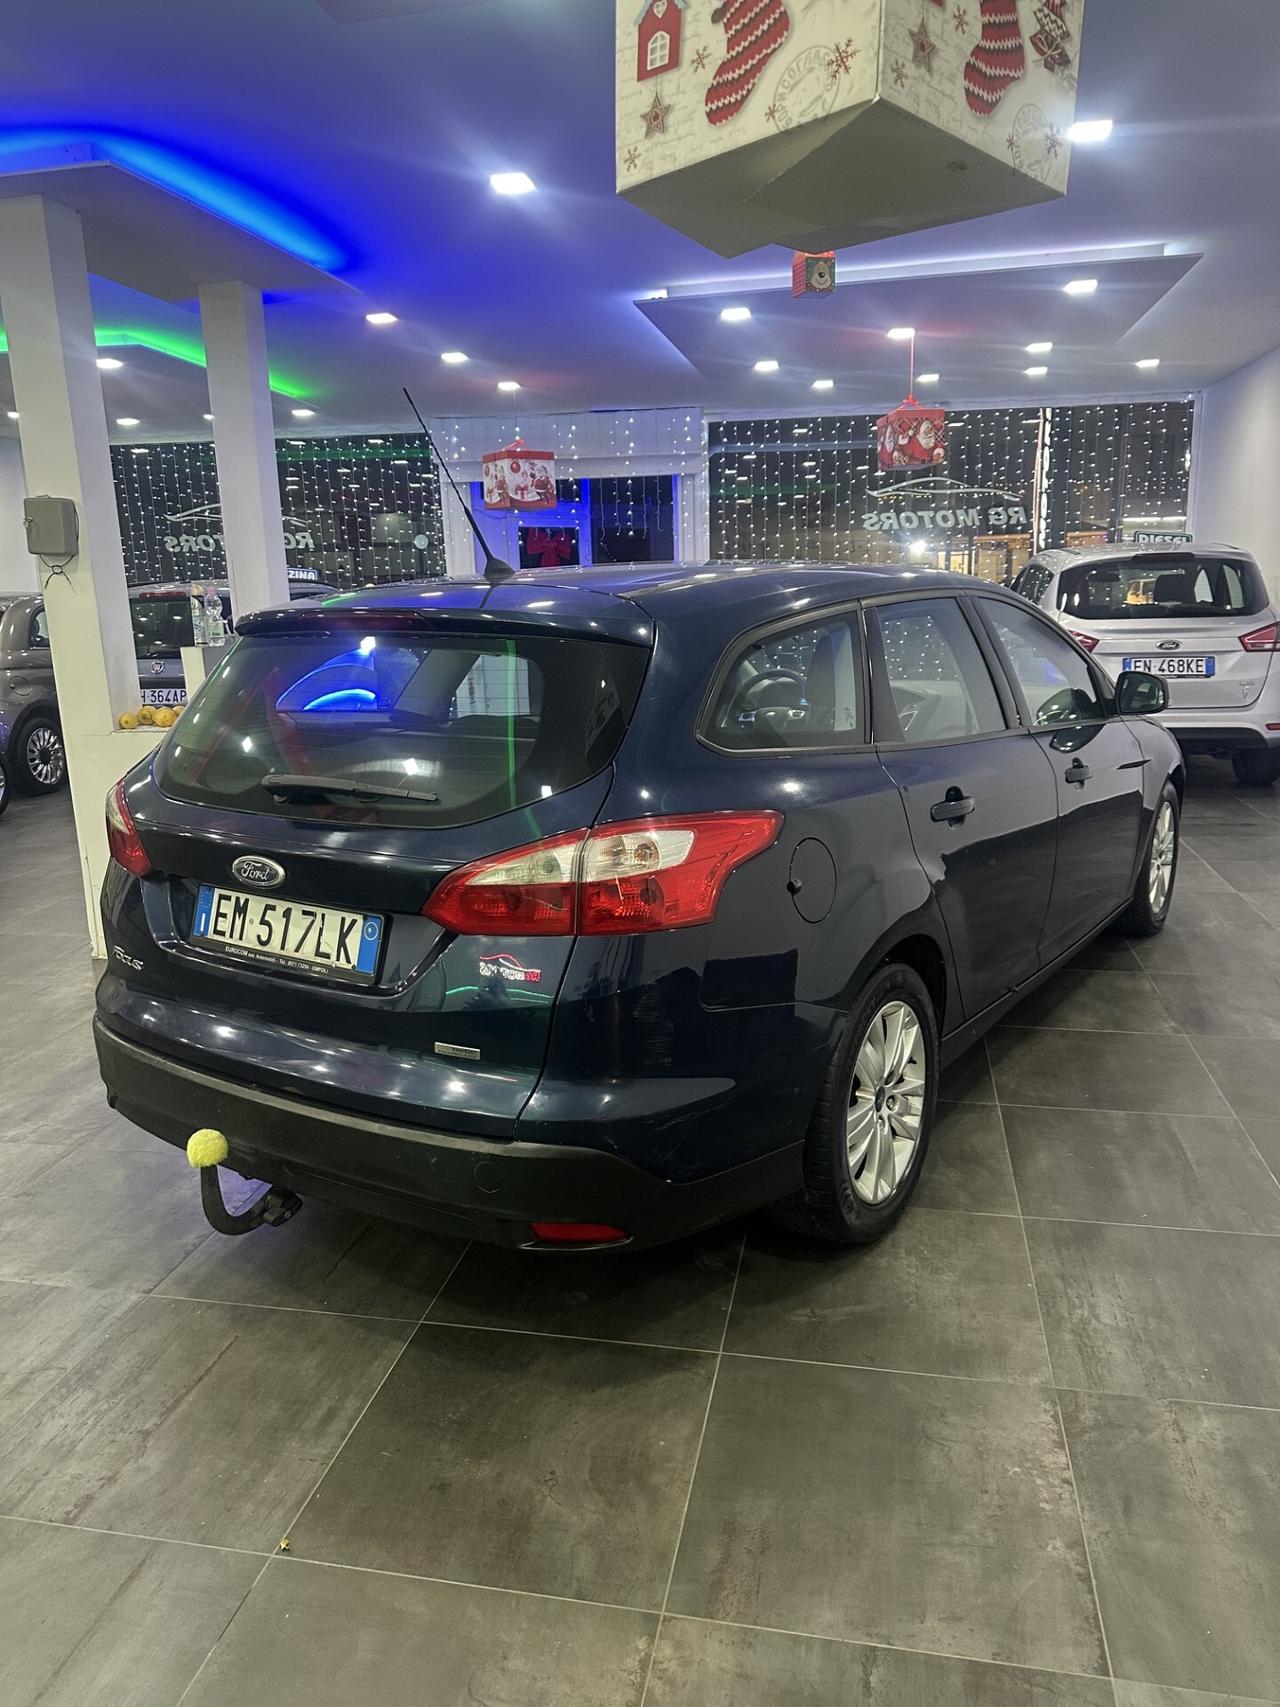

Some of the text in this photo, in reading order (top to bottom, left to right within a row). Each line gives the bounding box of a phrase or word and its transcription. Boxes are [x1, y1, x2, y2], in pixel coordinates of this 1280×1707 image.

[288, 570, 315, 581] ZINA
[1158, 659, 1204, 673] 468KE
[150, 689, 187, 703] 364AP
[241, 861, 271, 881] Ford
[213, 893, 250, 941] EM
[256, 903, 358, 964] 517LK
